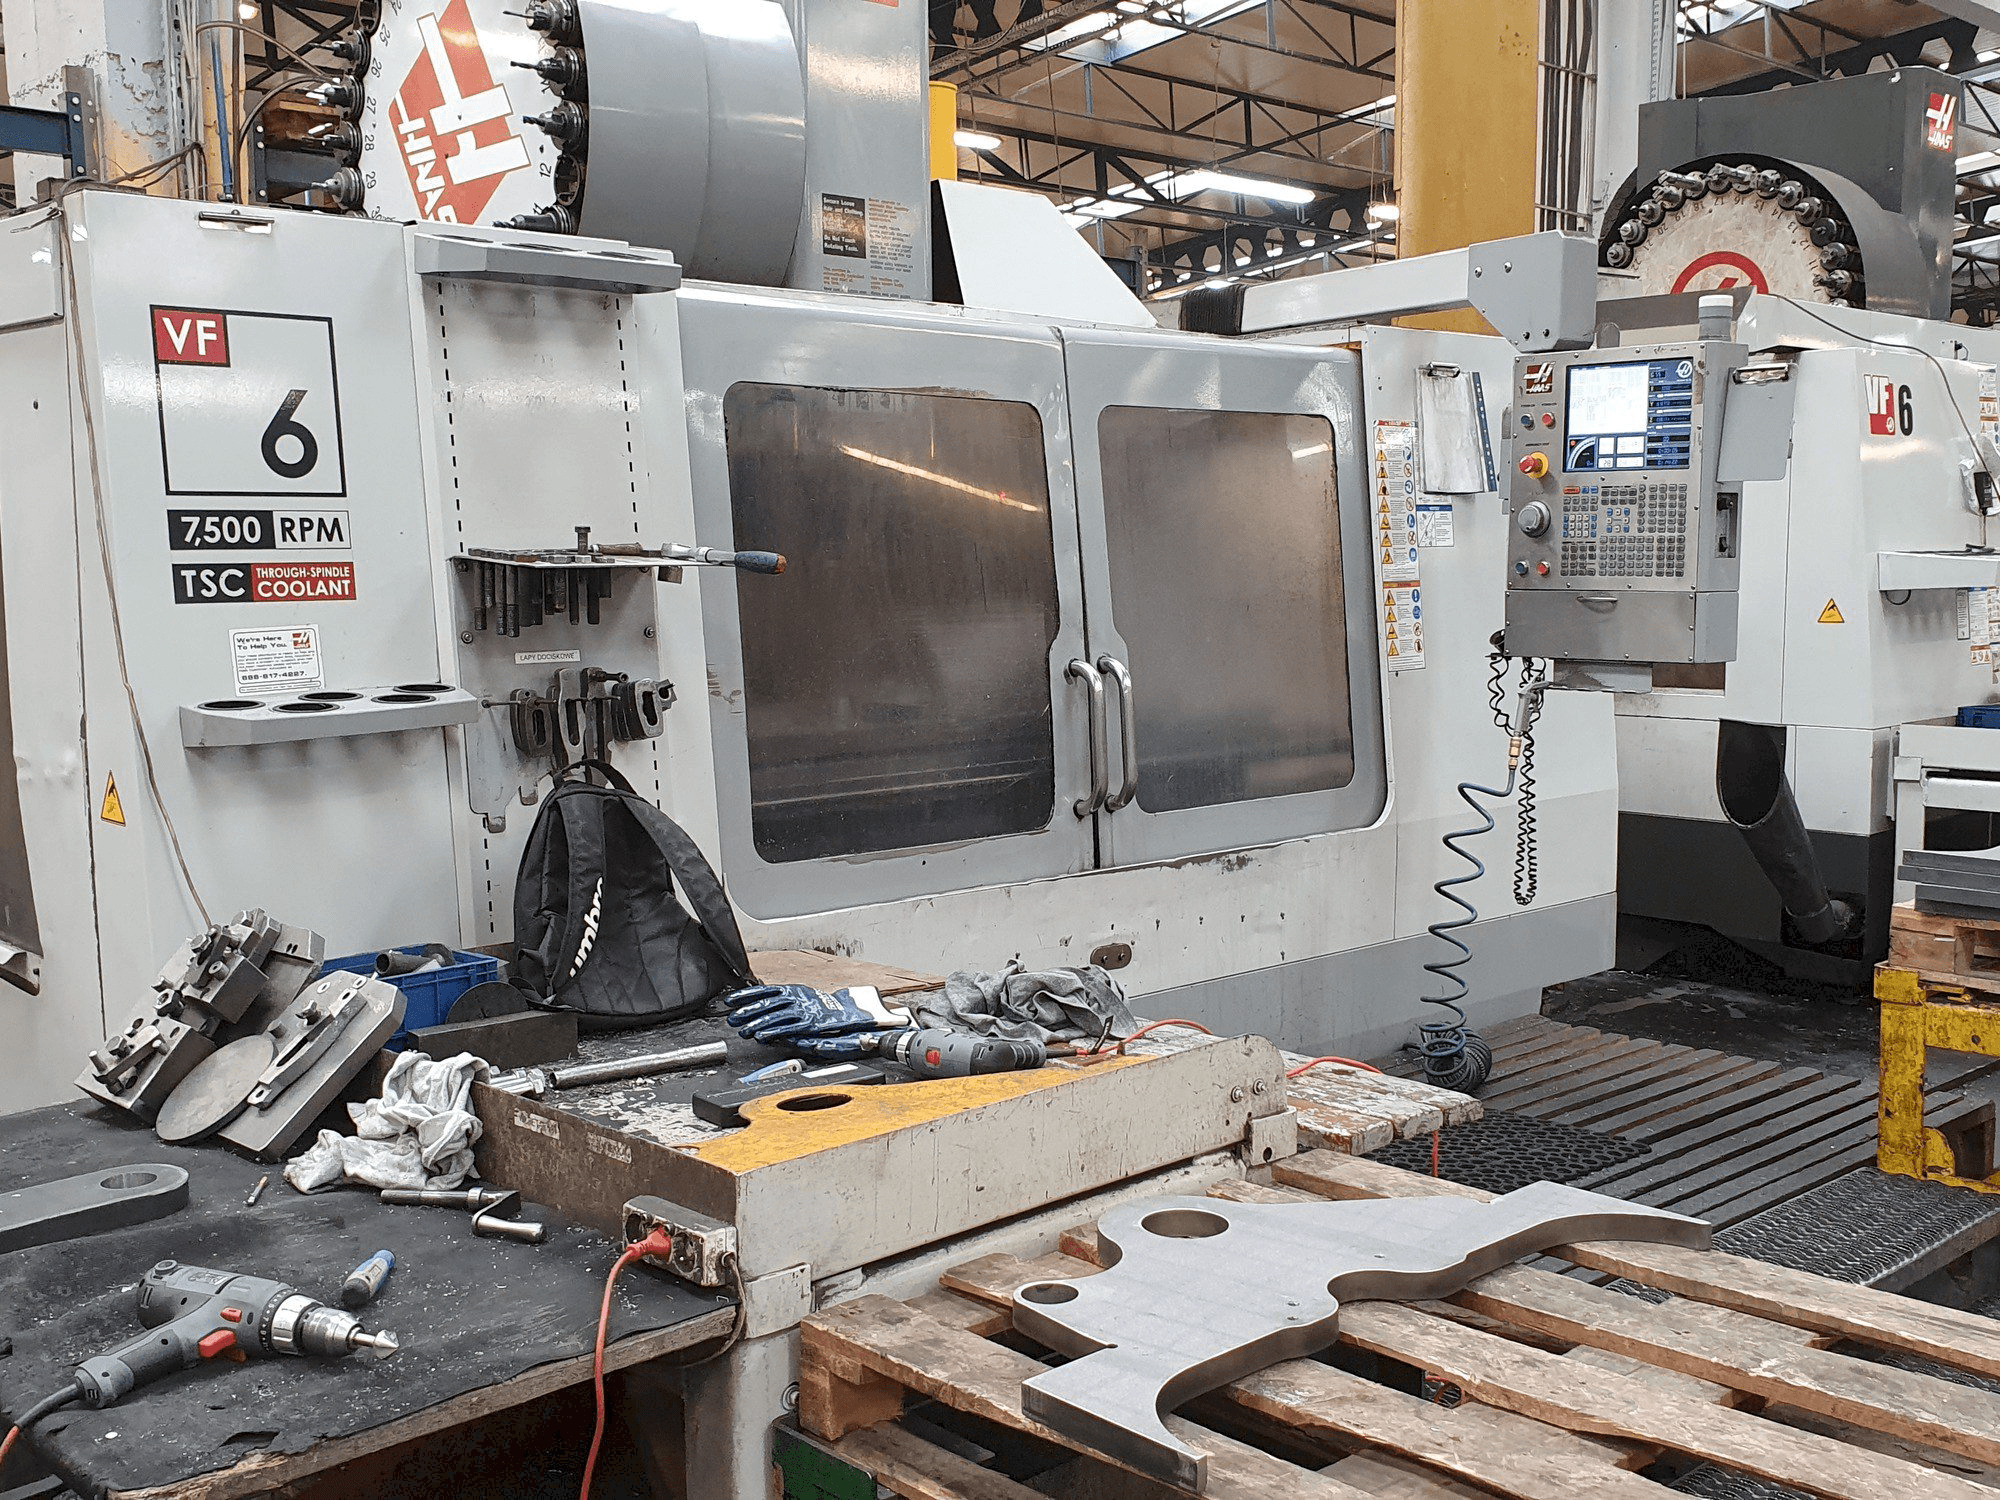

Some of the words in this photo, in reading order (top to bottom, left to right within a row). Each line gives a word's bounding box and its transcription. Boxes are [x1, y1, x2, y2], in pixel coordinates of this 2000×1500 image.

[379, 22, 391, 47] 25
[371, 57, 382, 78] 26
[366, 96, 377, 115] 27
[364, 134, 375, 151] 28
[365, 171, 377, 189] 29
[539, 162, 552, 178] 12
[162, 317, 218, 356] VF
[1863, 374, 1890, 414] VF
[1898, 384, 1914, 436] 6
[261, 389, 319, 479] 6
[180, 515, 262, 547] 7,500
[280, 517, 345, 543] RPM
[180, 568, 246, 598] TSC
[255, 566, 351, 579] THROUGH-SPINDLE
[256, 580, 352, 598] COOLANT
